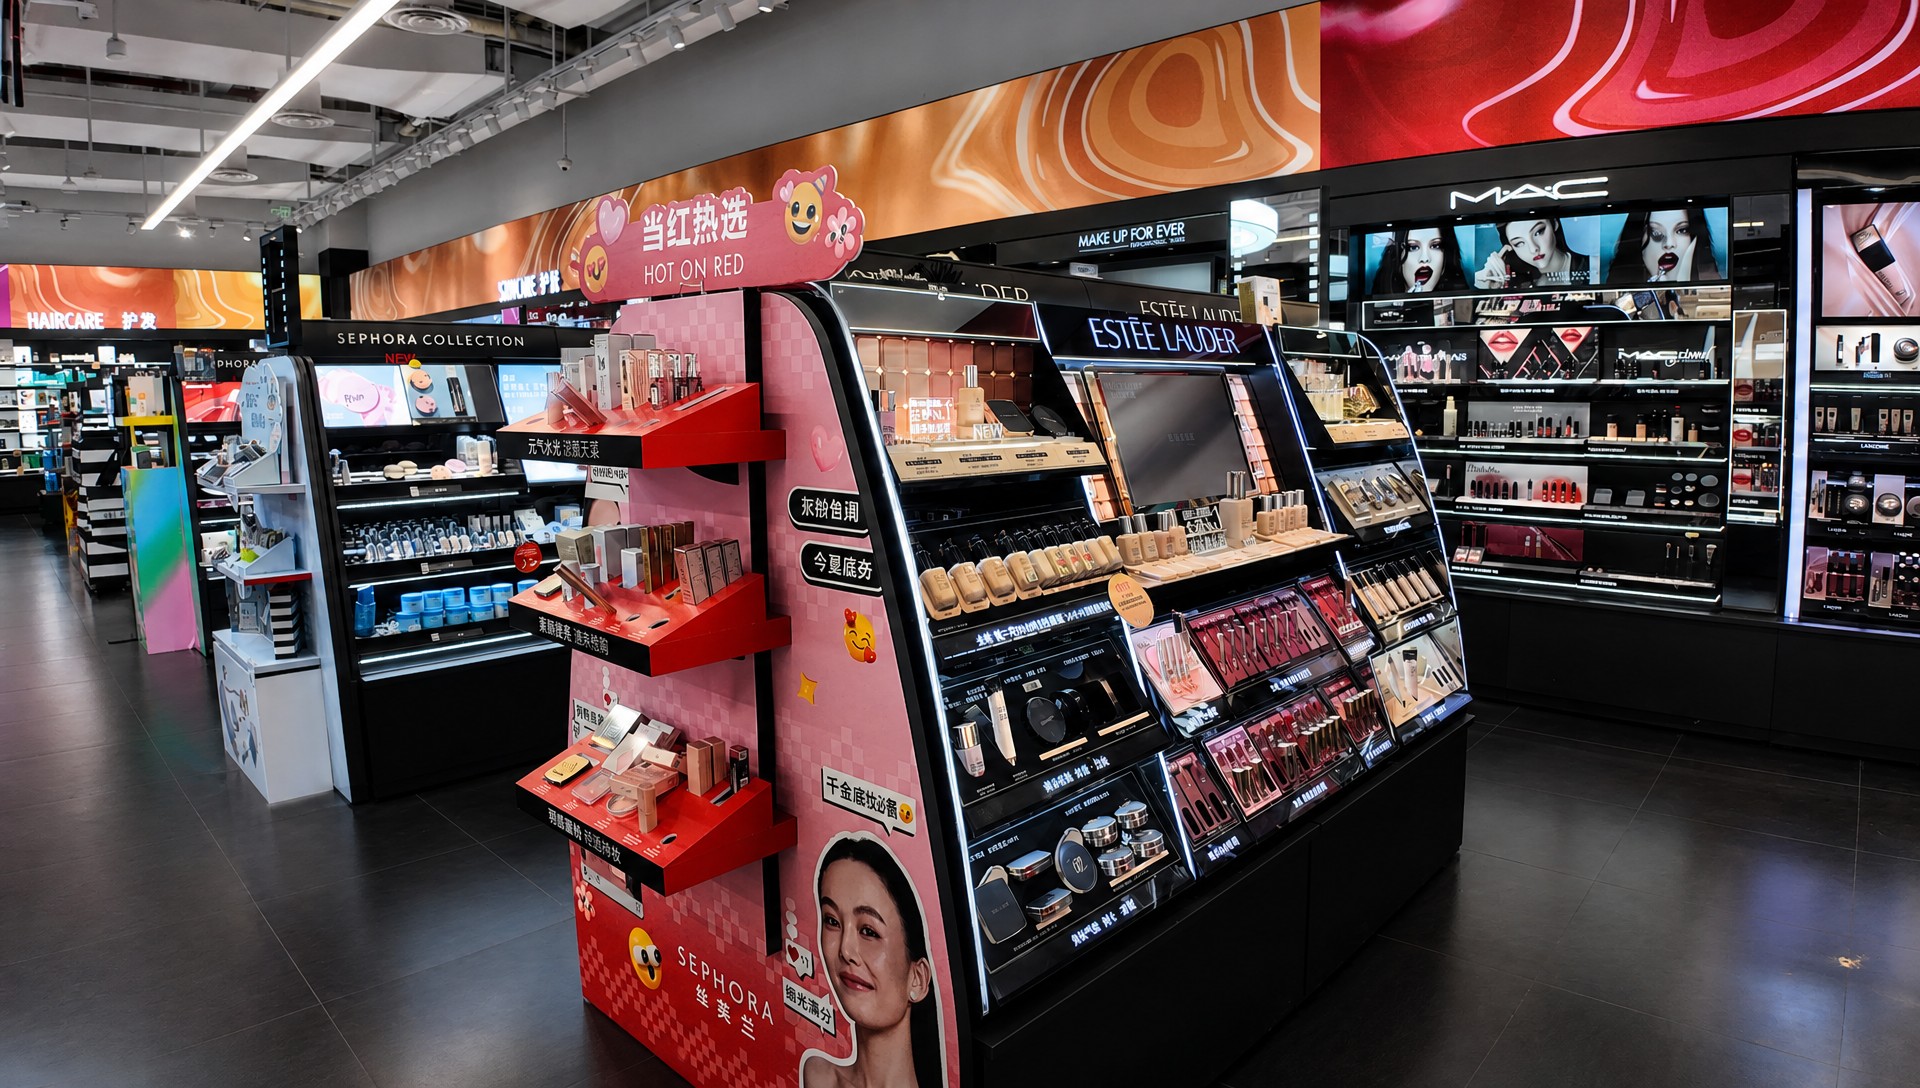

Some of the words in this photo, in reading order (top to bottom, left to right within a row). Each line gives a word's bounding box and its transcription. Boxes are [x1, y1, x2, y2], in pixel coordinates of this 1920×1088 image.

[642, 194, 748, 252] 当红热选
[1078, 231, 1111, 248] MAKE
[1113, 229, 1129, 243] UP
[1130, 225, 1154, 241] FOR
[1156, 222, 1186, 239] EVER
[644, 261, 675, 285] HOT
[680, 257, 707, 281] ON
[714, 253, 744, 278] RED
[27, 311, 105, 330] HAIRCARE
[121, 311, 157, 330] 护发
[337, 332, 418, 345] SEPHORA
[422, 334, 525, 347] COLLECTION
[1160, 323, 1240, 354] LAUDER
[973, 424, 1003, 440] NEW
[678, 945, 774, 1026] SEPHORA
[696, 983, 756, 1041] 丝芙兰
